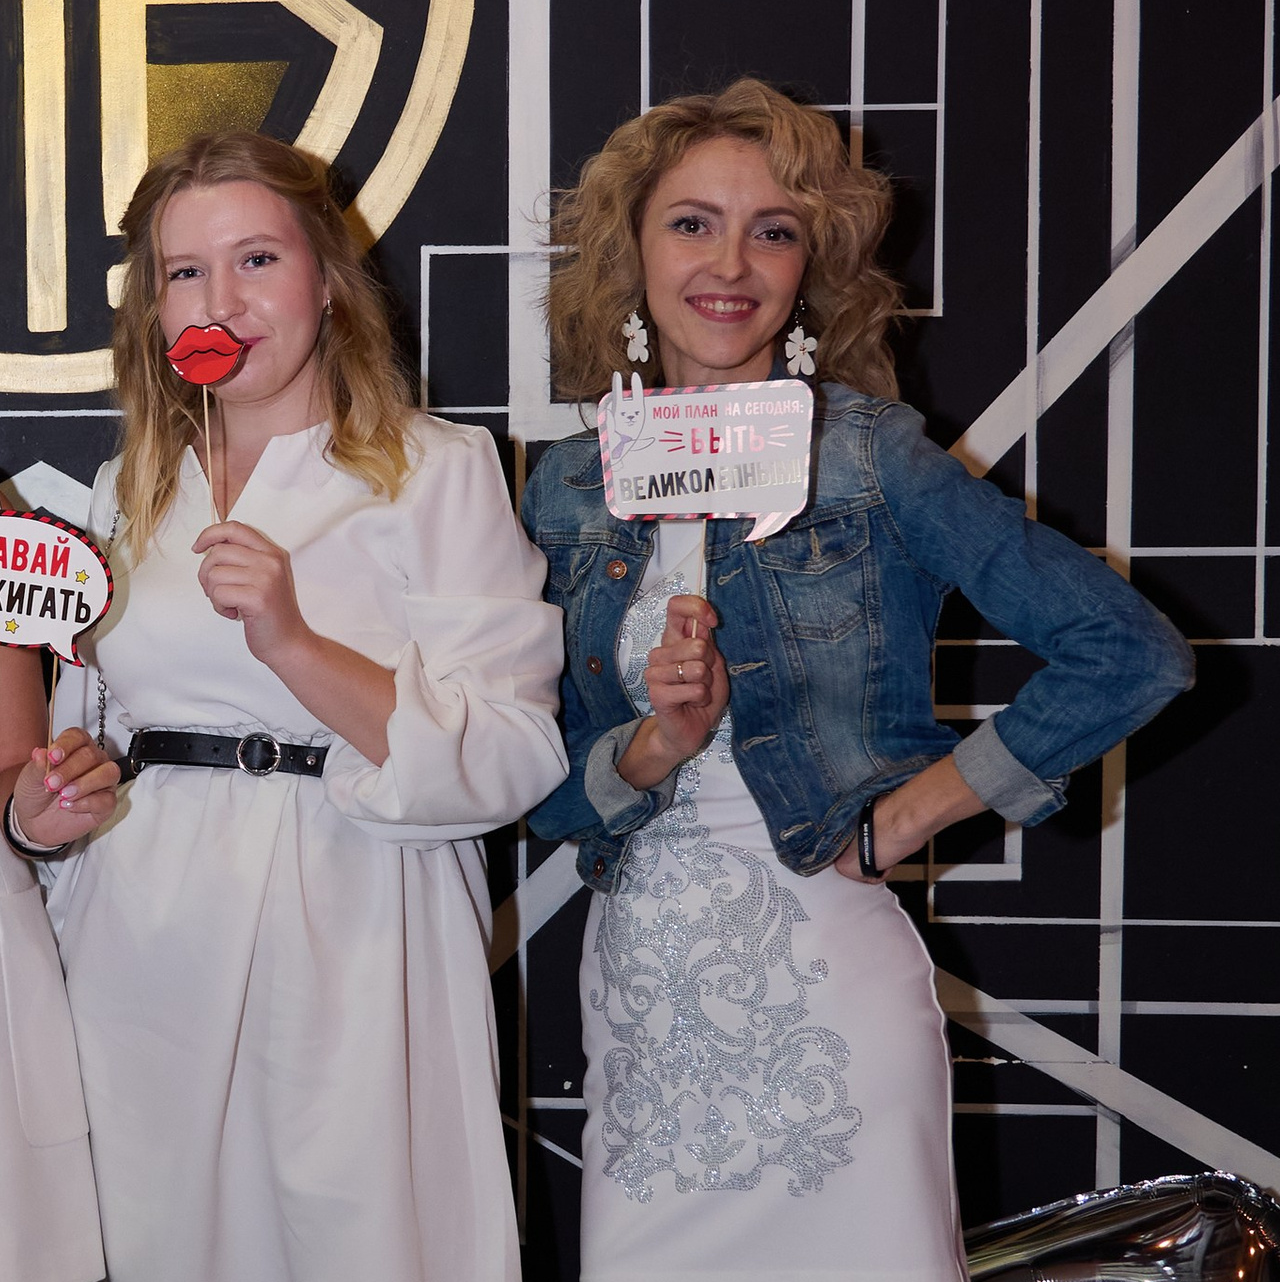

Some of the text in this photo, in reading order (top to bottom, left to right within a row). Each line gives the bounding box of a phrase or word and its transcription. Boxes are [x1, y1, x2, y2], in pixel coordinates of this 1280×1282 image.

[652, 399, 805, 419] МОЙ ПЛАН НА СЕГОДНЯ:
[691, 425, 765, 455] БЫТЬ
[618, 457, 802, 504] ВЕЛИКОЛЕПНЫМ!
